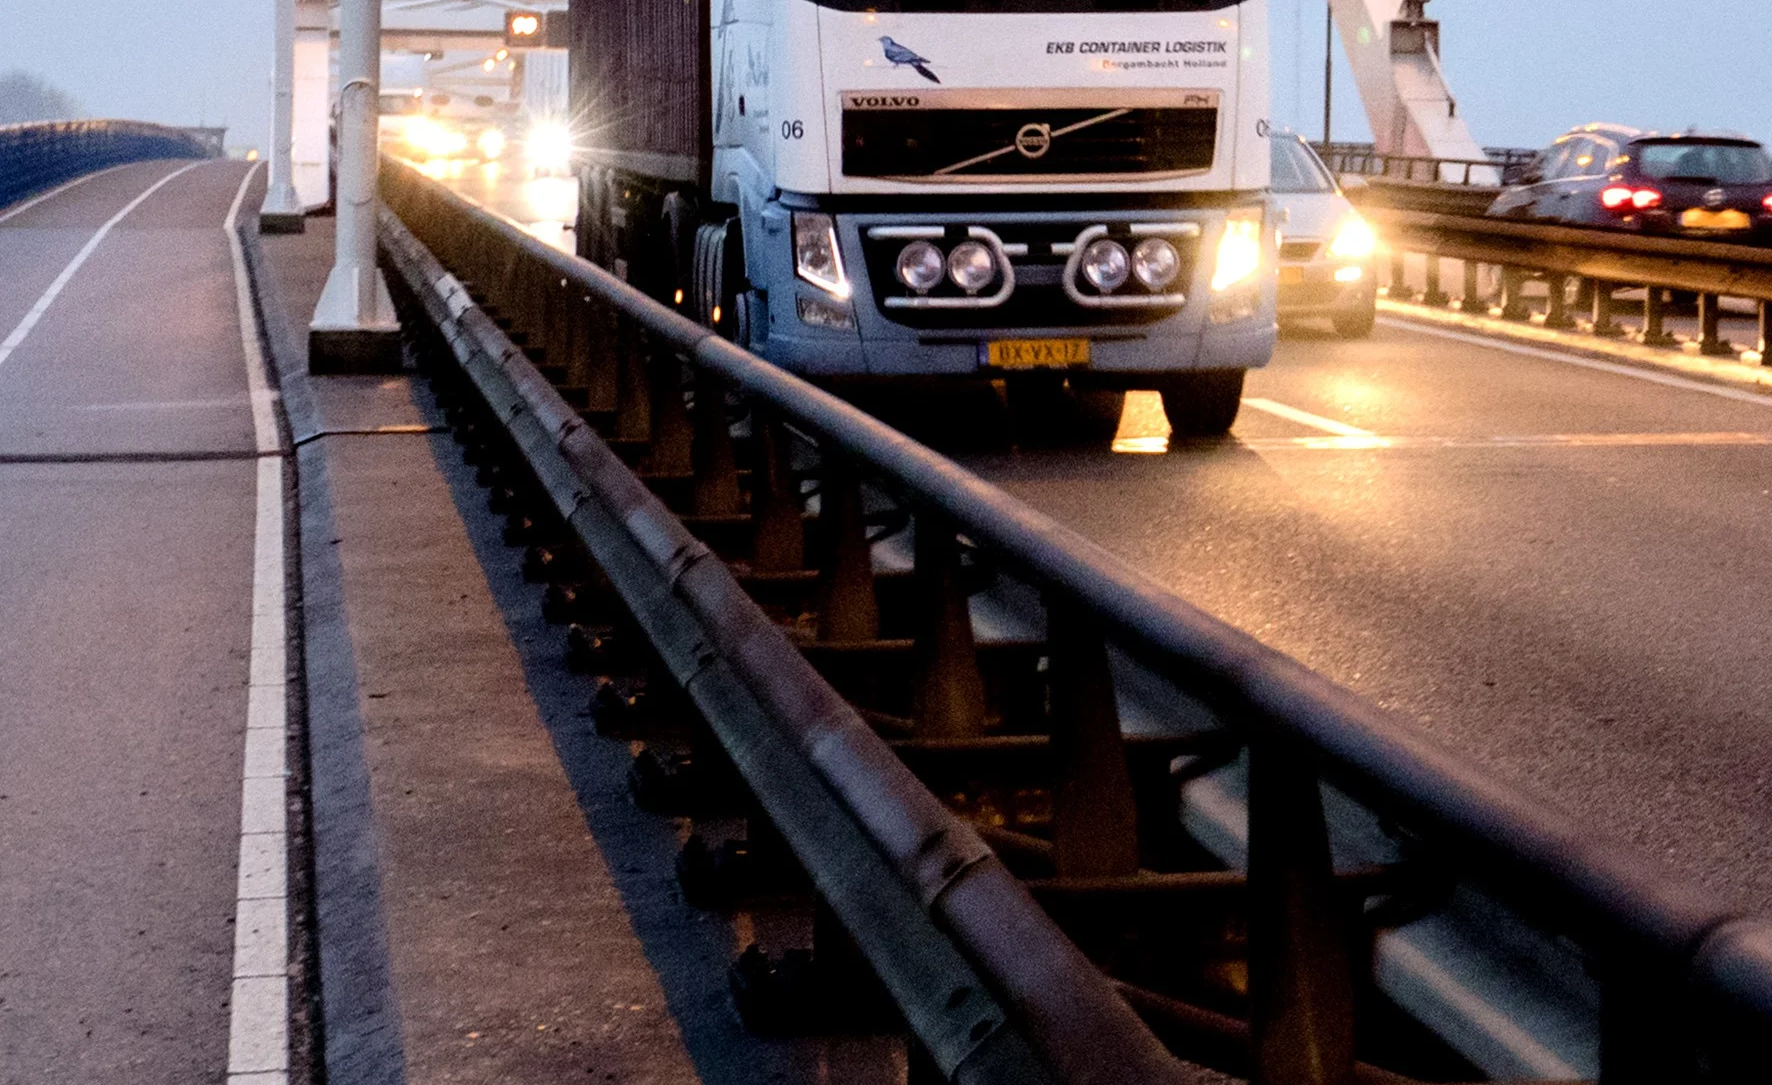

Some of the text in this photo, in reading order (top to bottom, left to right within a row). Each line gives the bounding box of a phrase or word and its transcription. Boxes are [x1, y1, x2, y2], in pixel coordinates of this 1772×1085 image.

[1046, 41, 1227, 54] EKB CONTAINER LOGISTIK
[1183, 59, 1228, 68] Holland
[851, 97, 920, 107] VOLVO
[781, 120, 804, 140] 06
